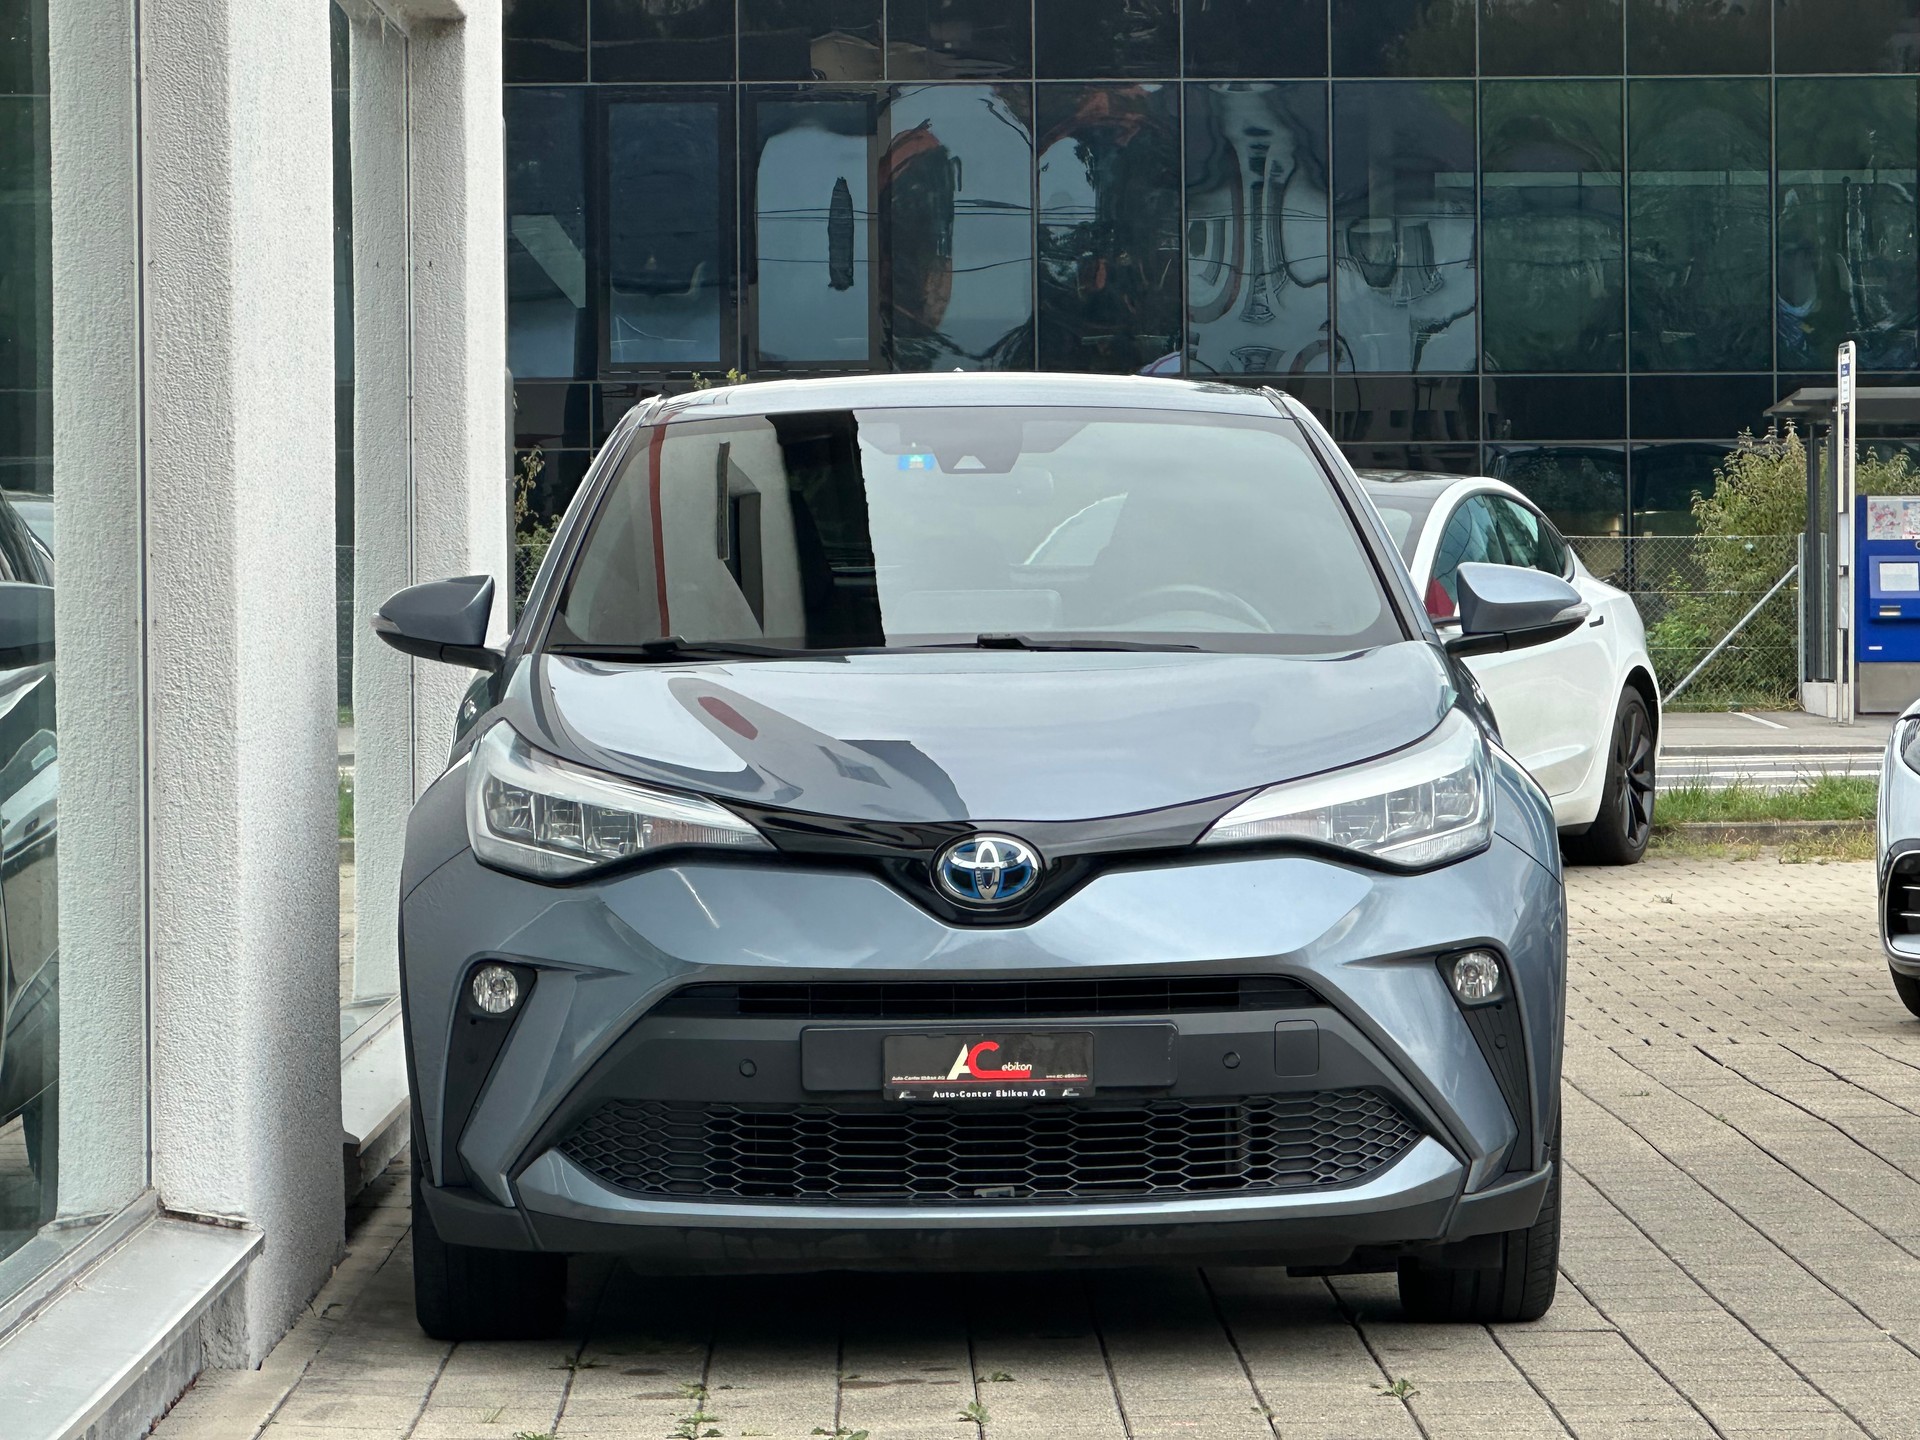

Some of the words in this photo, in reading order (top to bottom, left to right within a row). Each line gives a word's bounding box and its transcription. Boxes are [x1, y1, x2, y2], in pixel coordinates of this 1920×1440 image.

[947, 1041, 1030, 1080] AC
[1001, 1062, 1032, 1071] ebikon
[932, 1090, 992, 1098] Auto-Center
[995, 1089, 1029, 1098] Ebikon
[1032, 1089, 1046, 1097] AG
